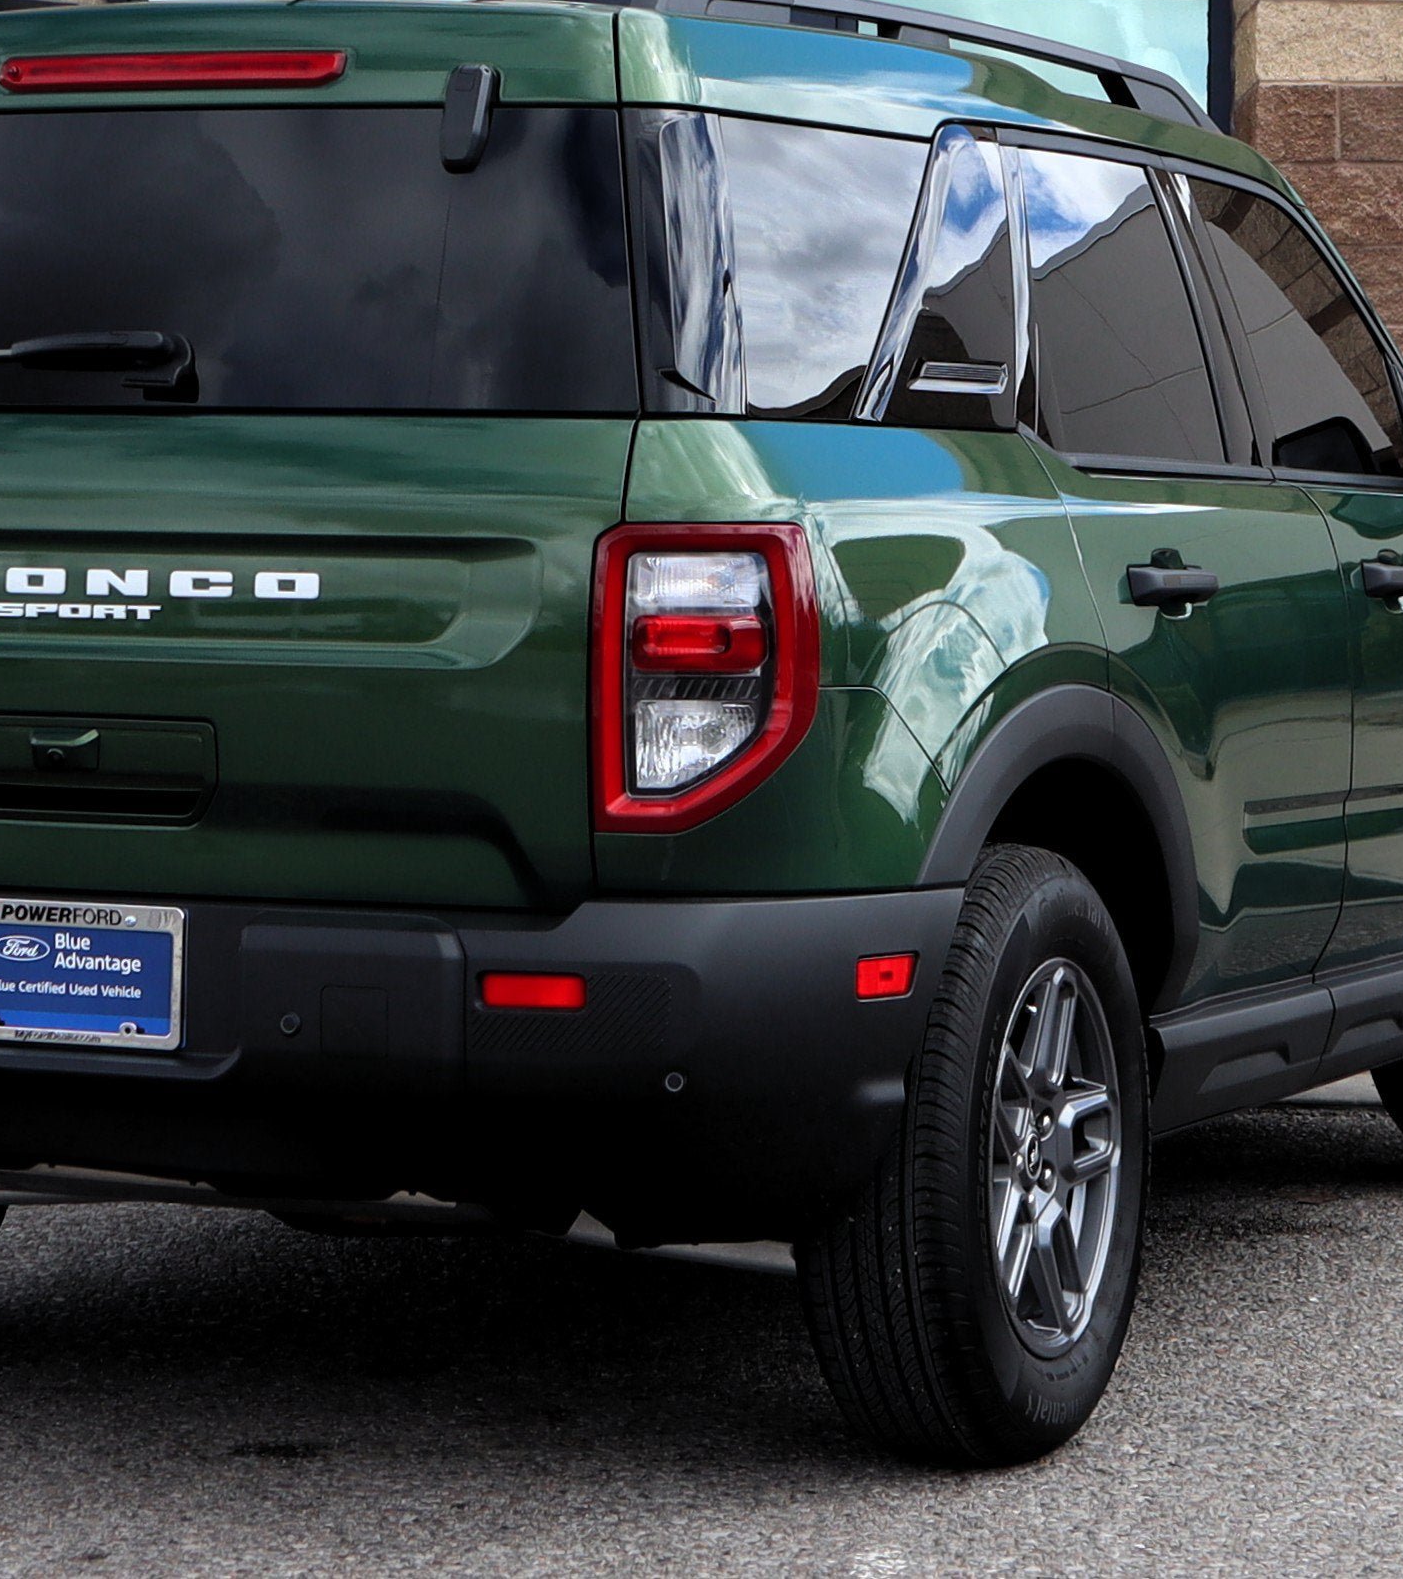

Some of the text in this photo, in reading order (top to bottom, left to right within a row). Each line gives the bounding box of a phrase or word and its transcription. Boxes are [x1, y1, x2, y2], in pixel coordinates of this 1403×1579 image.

[0, 904, 122, 926] POWERFORD
[1, 937, 40, 958] Ford
[54, 932, 91, 951] Blue
[53, 954, 142, 975] Advantage
[18, 980, 66, 995] Certified
[69, 983, 98, 997] Used
[101, 984, 142, 999] Vehicle
